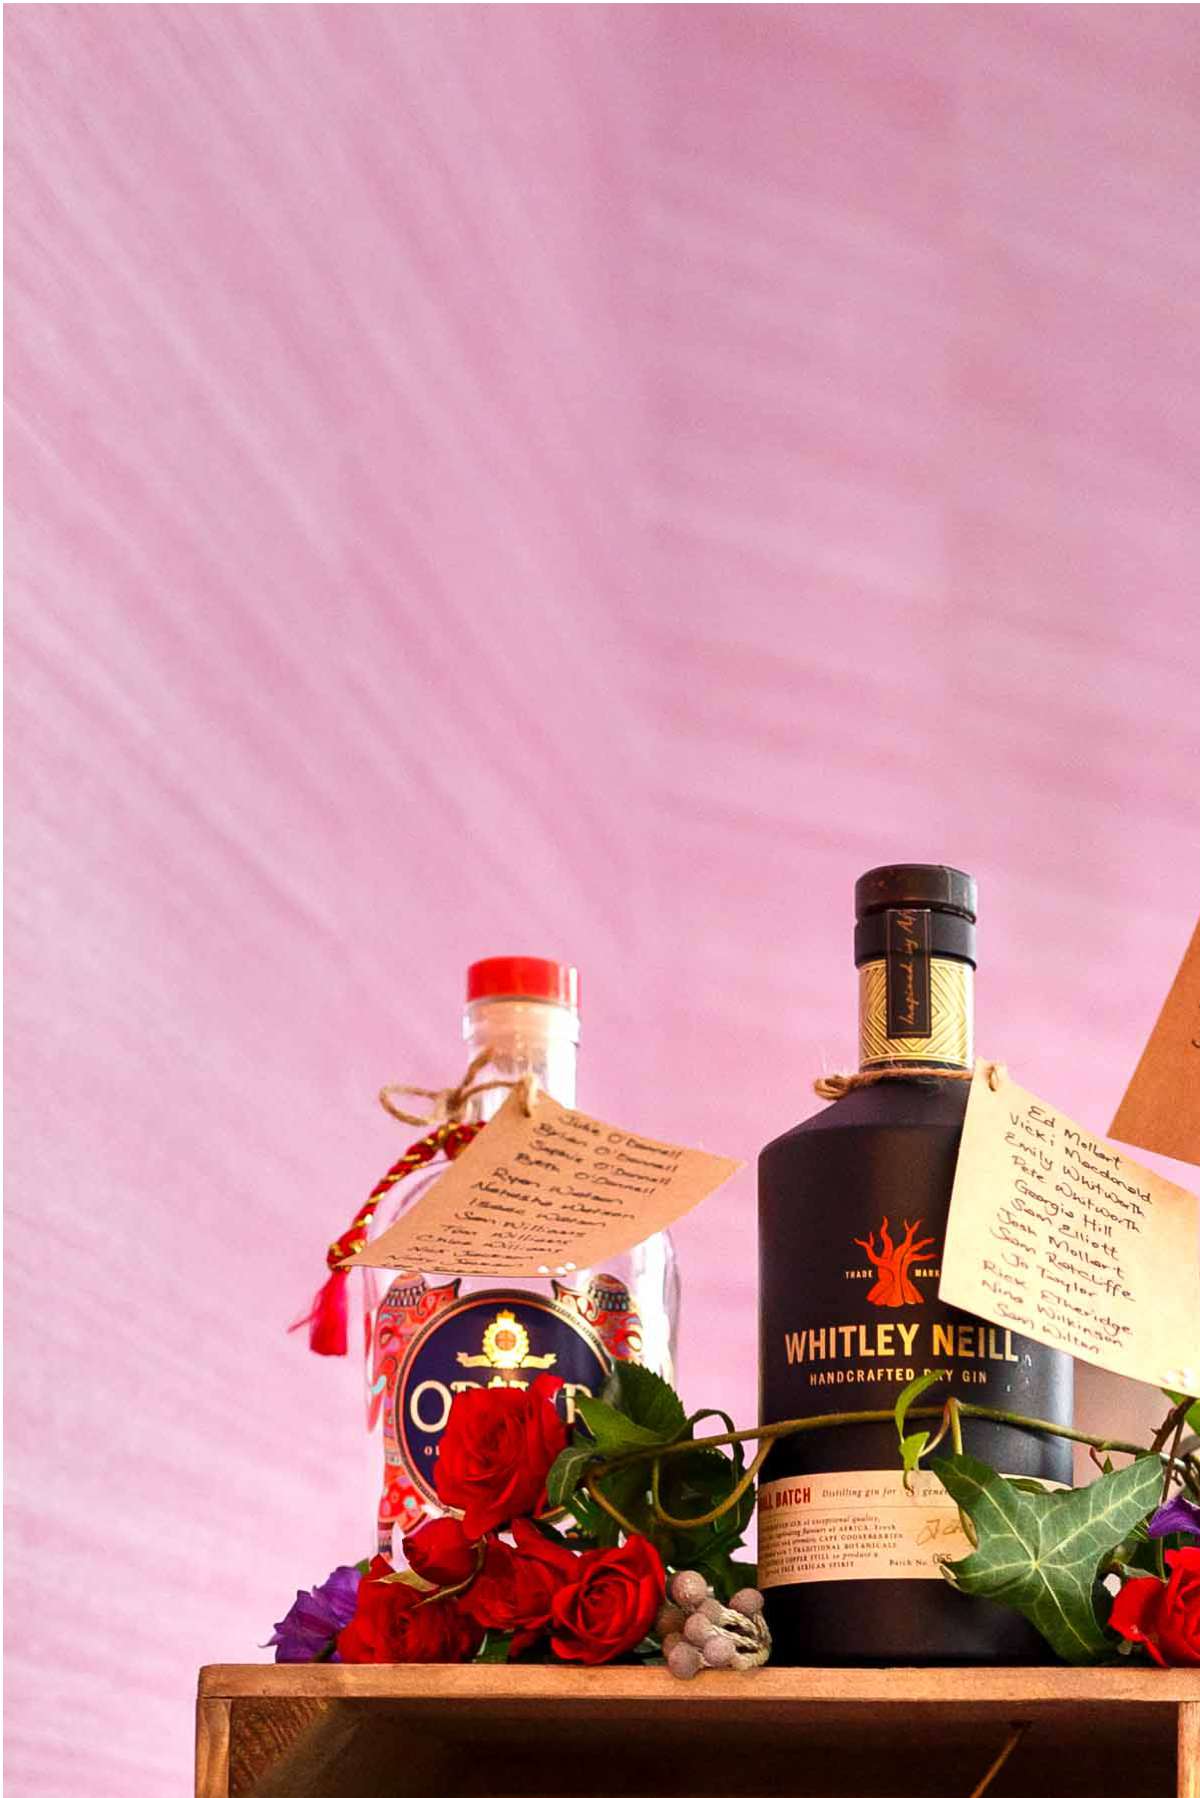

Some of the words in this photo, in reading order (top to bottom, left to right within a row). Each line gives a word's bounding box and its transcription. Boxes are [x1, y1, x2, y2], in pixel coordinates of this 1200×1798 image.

[845, 1270, 874, 1280] TRADE
[915, 1269, 941, 1278] MARK
[785, 1323, 920, 1365] WHITLEY
[933, 1326, 1018, 1362] NEILL
[809, 1367, 915, 1387] HANDCRAFTED
[962, 1370, 988, 1385] GIN
[775, 1487, 811, 1509] BATCH
[821, 1487, 862, 1498] Distilling
[864, 1489, 880, 1499] gin
[882, 1487, 897, 1498] for
[889, 1558, 912, 1568] Batch
